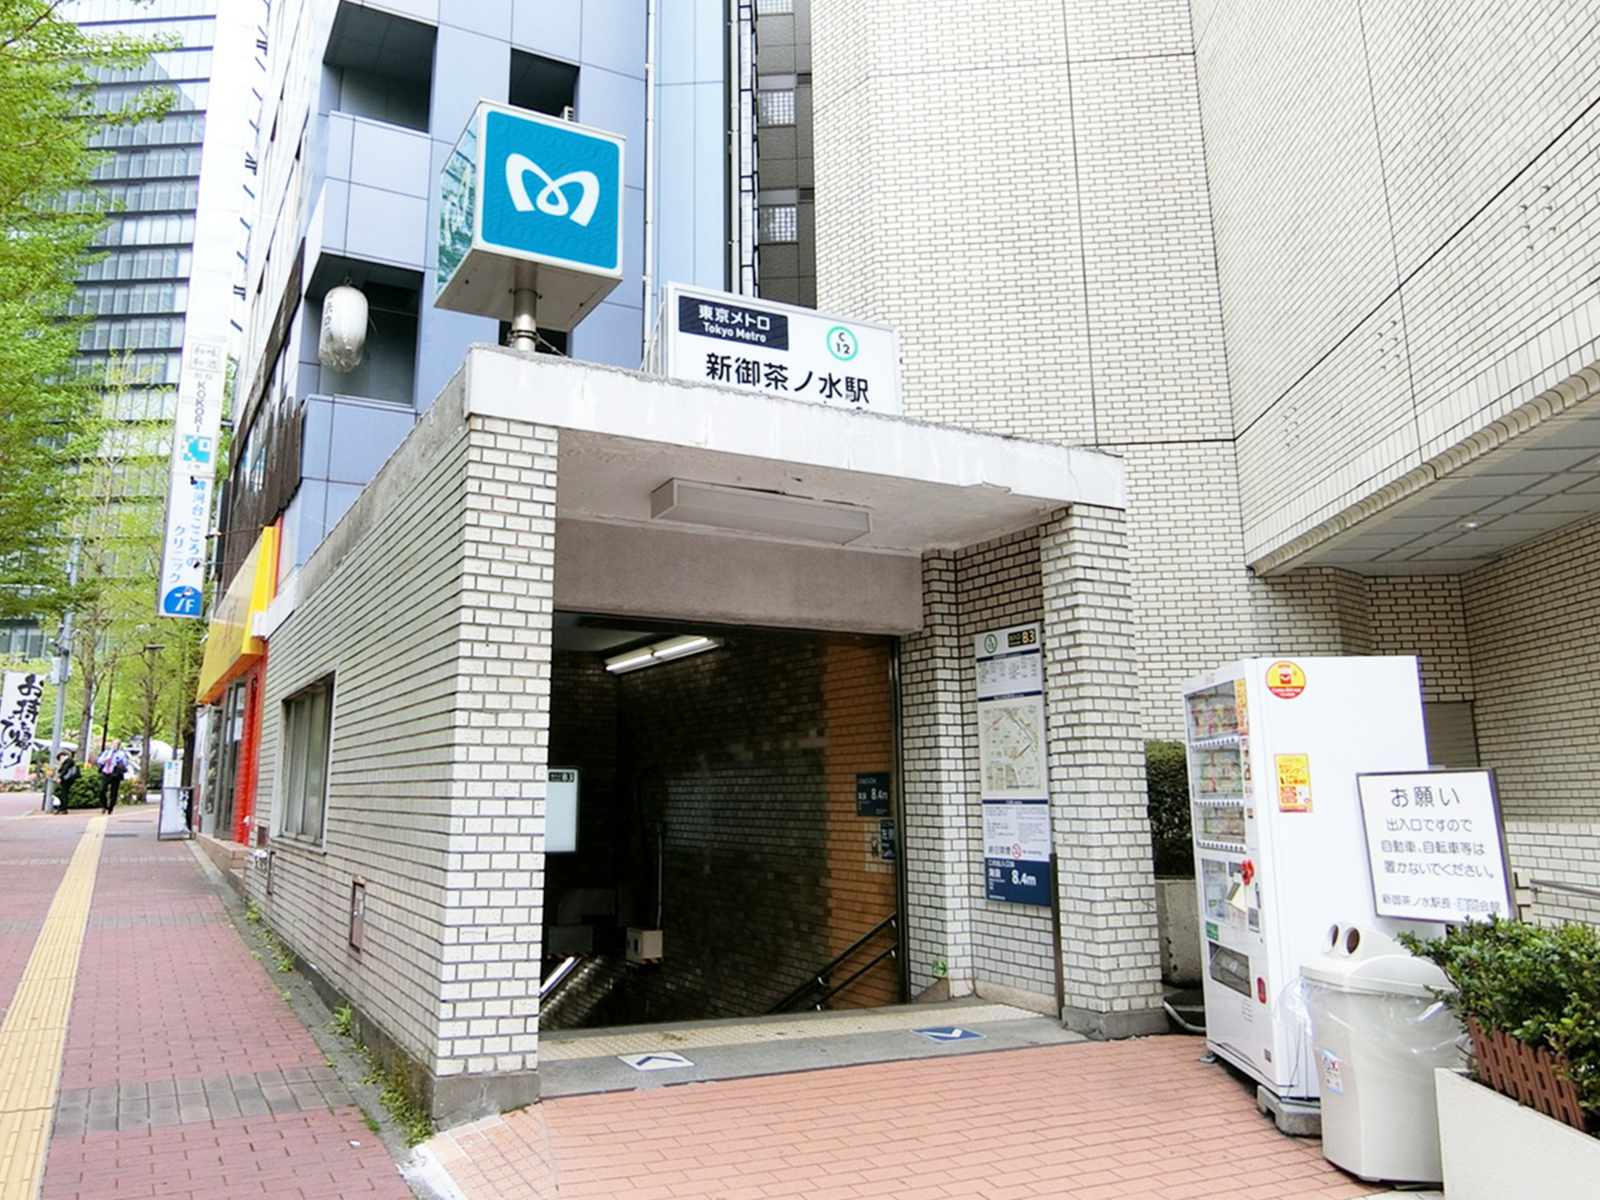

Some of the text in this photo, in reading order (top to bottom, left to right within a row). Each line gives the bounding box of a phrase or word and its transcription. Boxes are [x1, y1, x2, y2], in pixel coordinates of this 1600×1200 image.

[698, 304, 771, 331] 東京メトロ
[703, 322, 767, 343] Tokyo Metro
[838, 332, 846, 342] C
[836, 343, 850, 354] 12
[706, 352, 870, 404] 新御茶ノ水駅
[194, 381, 206, 433] KOKORI
[170, 525, 186, 584] クリニック
[174, 592, 195, 613] 7F
[1390, 786, 1460, 808] お願い
[1386, 818, 1472, 833] 出入口ですので
[1381, 840, 1485, 856] 自動車、自転車等は
[1011, 869, 1037, 886] 8.4m
[1384, 860, 1494, 879] 置かないでください。
